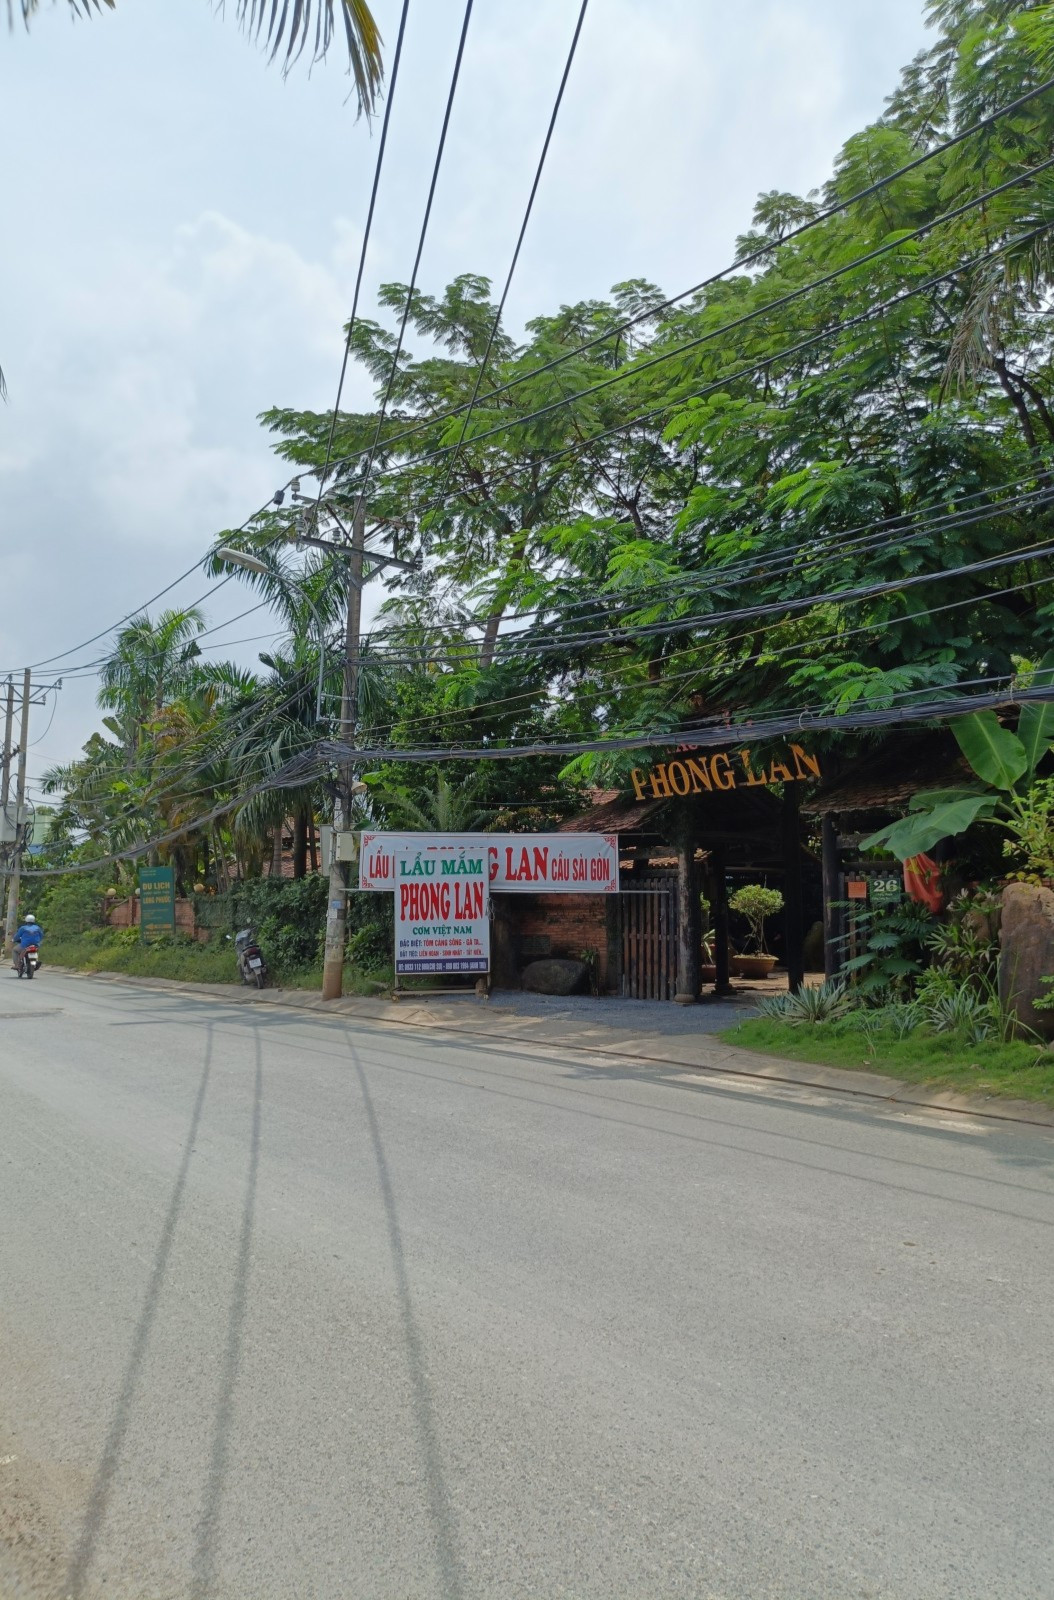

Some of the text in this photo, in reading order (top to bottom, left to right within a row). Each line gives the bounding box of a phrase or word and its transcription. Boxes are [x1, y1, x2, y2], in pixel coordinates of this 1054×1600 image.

[630, 752, 737, 800] PHONG
[400, 851, 436, 876] LẨU
[440, 850, 484, 875] MẮM
[505, 846, 549, 881] LAN
[551, 850, 570, 881] CẦU
[572, 853, 588, 881] SÀI
[590, 852, 610, 881] GÒN
[873, 879, 898, 892] 26
[400, 881, 484, 921] PHONG LAN
[412, 923, 472, 937] CƠM VIỆT NAM
